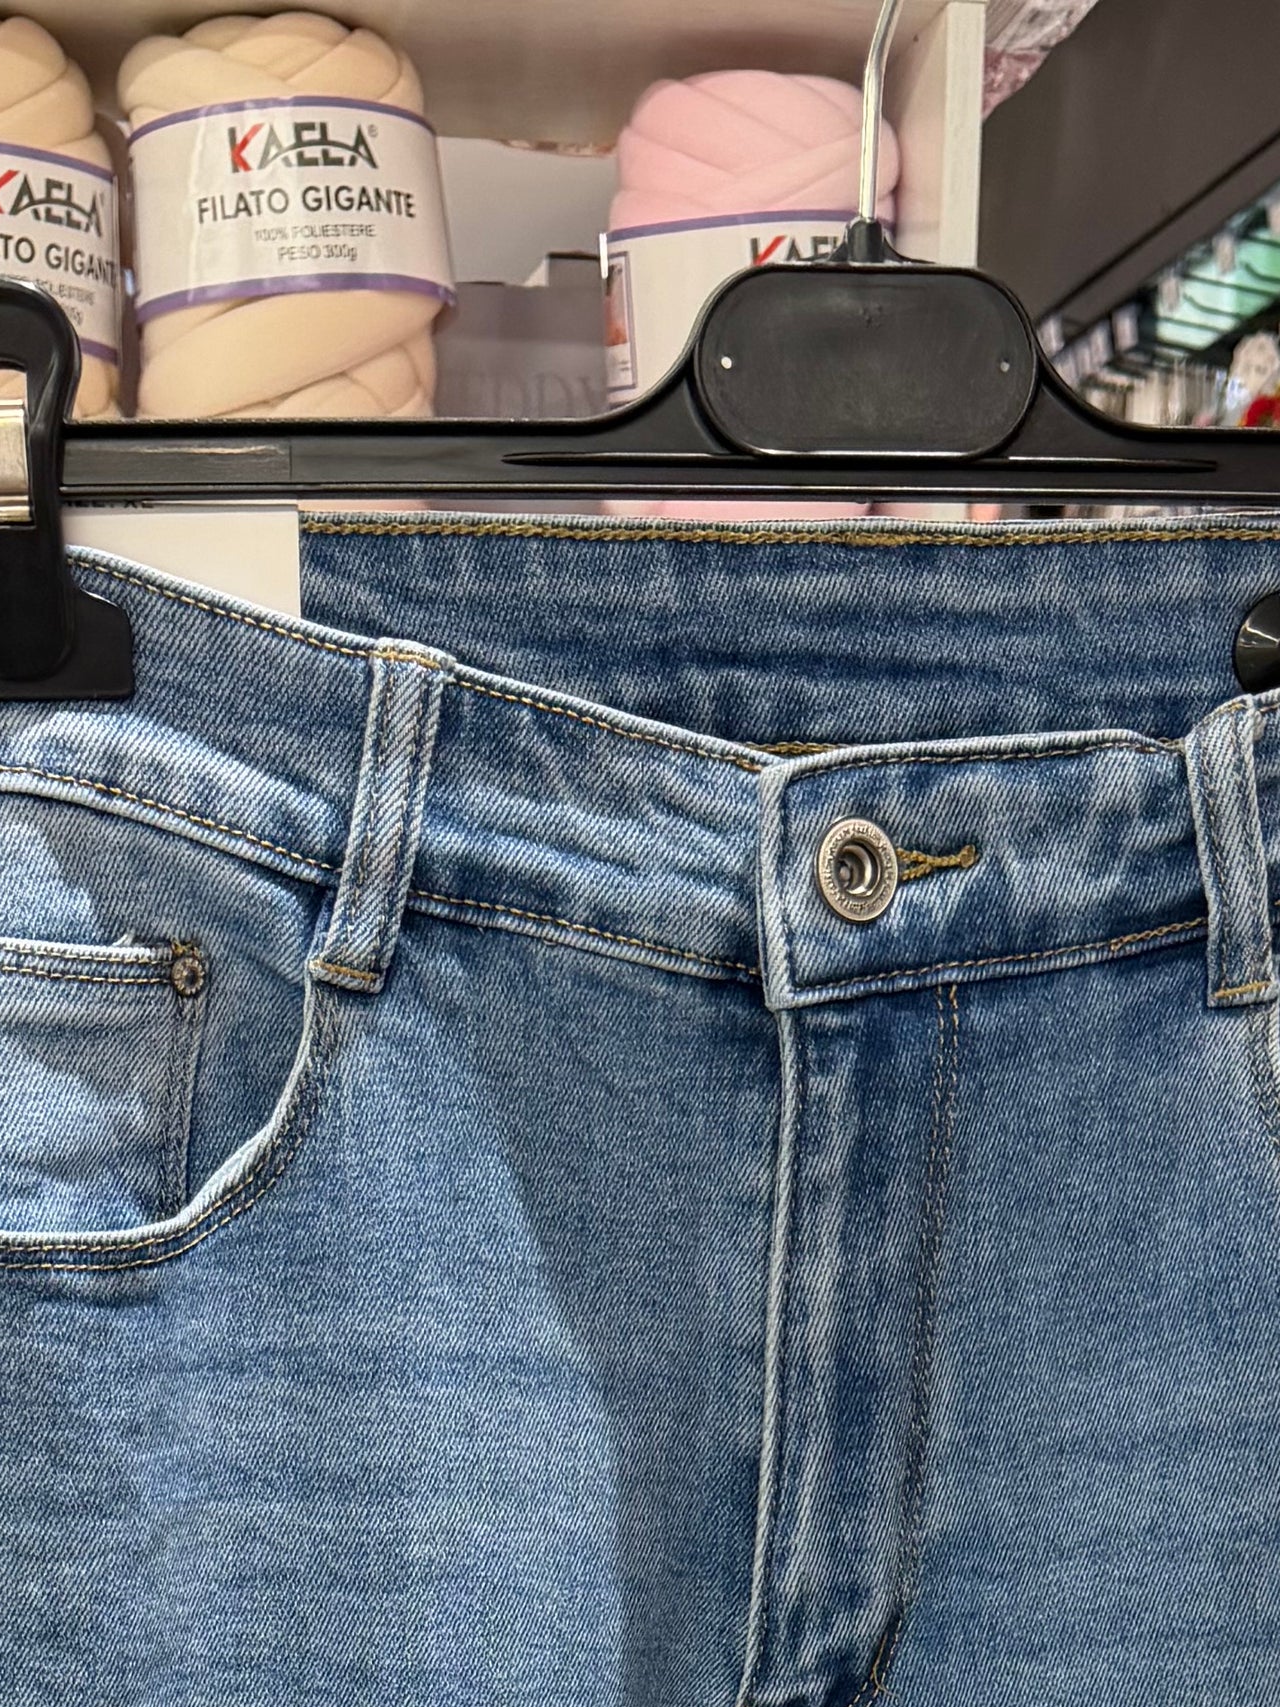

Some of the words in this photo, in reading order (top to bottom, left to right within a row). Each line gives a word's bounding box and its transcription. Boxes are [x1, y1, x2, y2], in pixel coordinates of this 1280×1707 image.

[228, 121, 379, 174] KAELA
[197, 187, 290, 225] FILATO
[302, 185, 417, 219] GIGANTE
[277, 245, 321, 262] PESO
